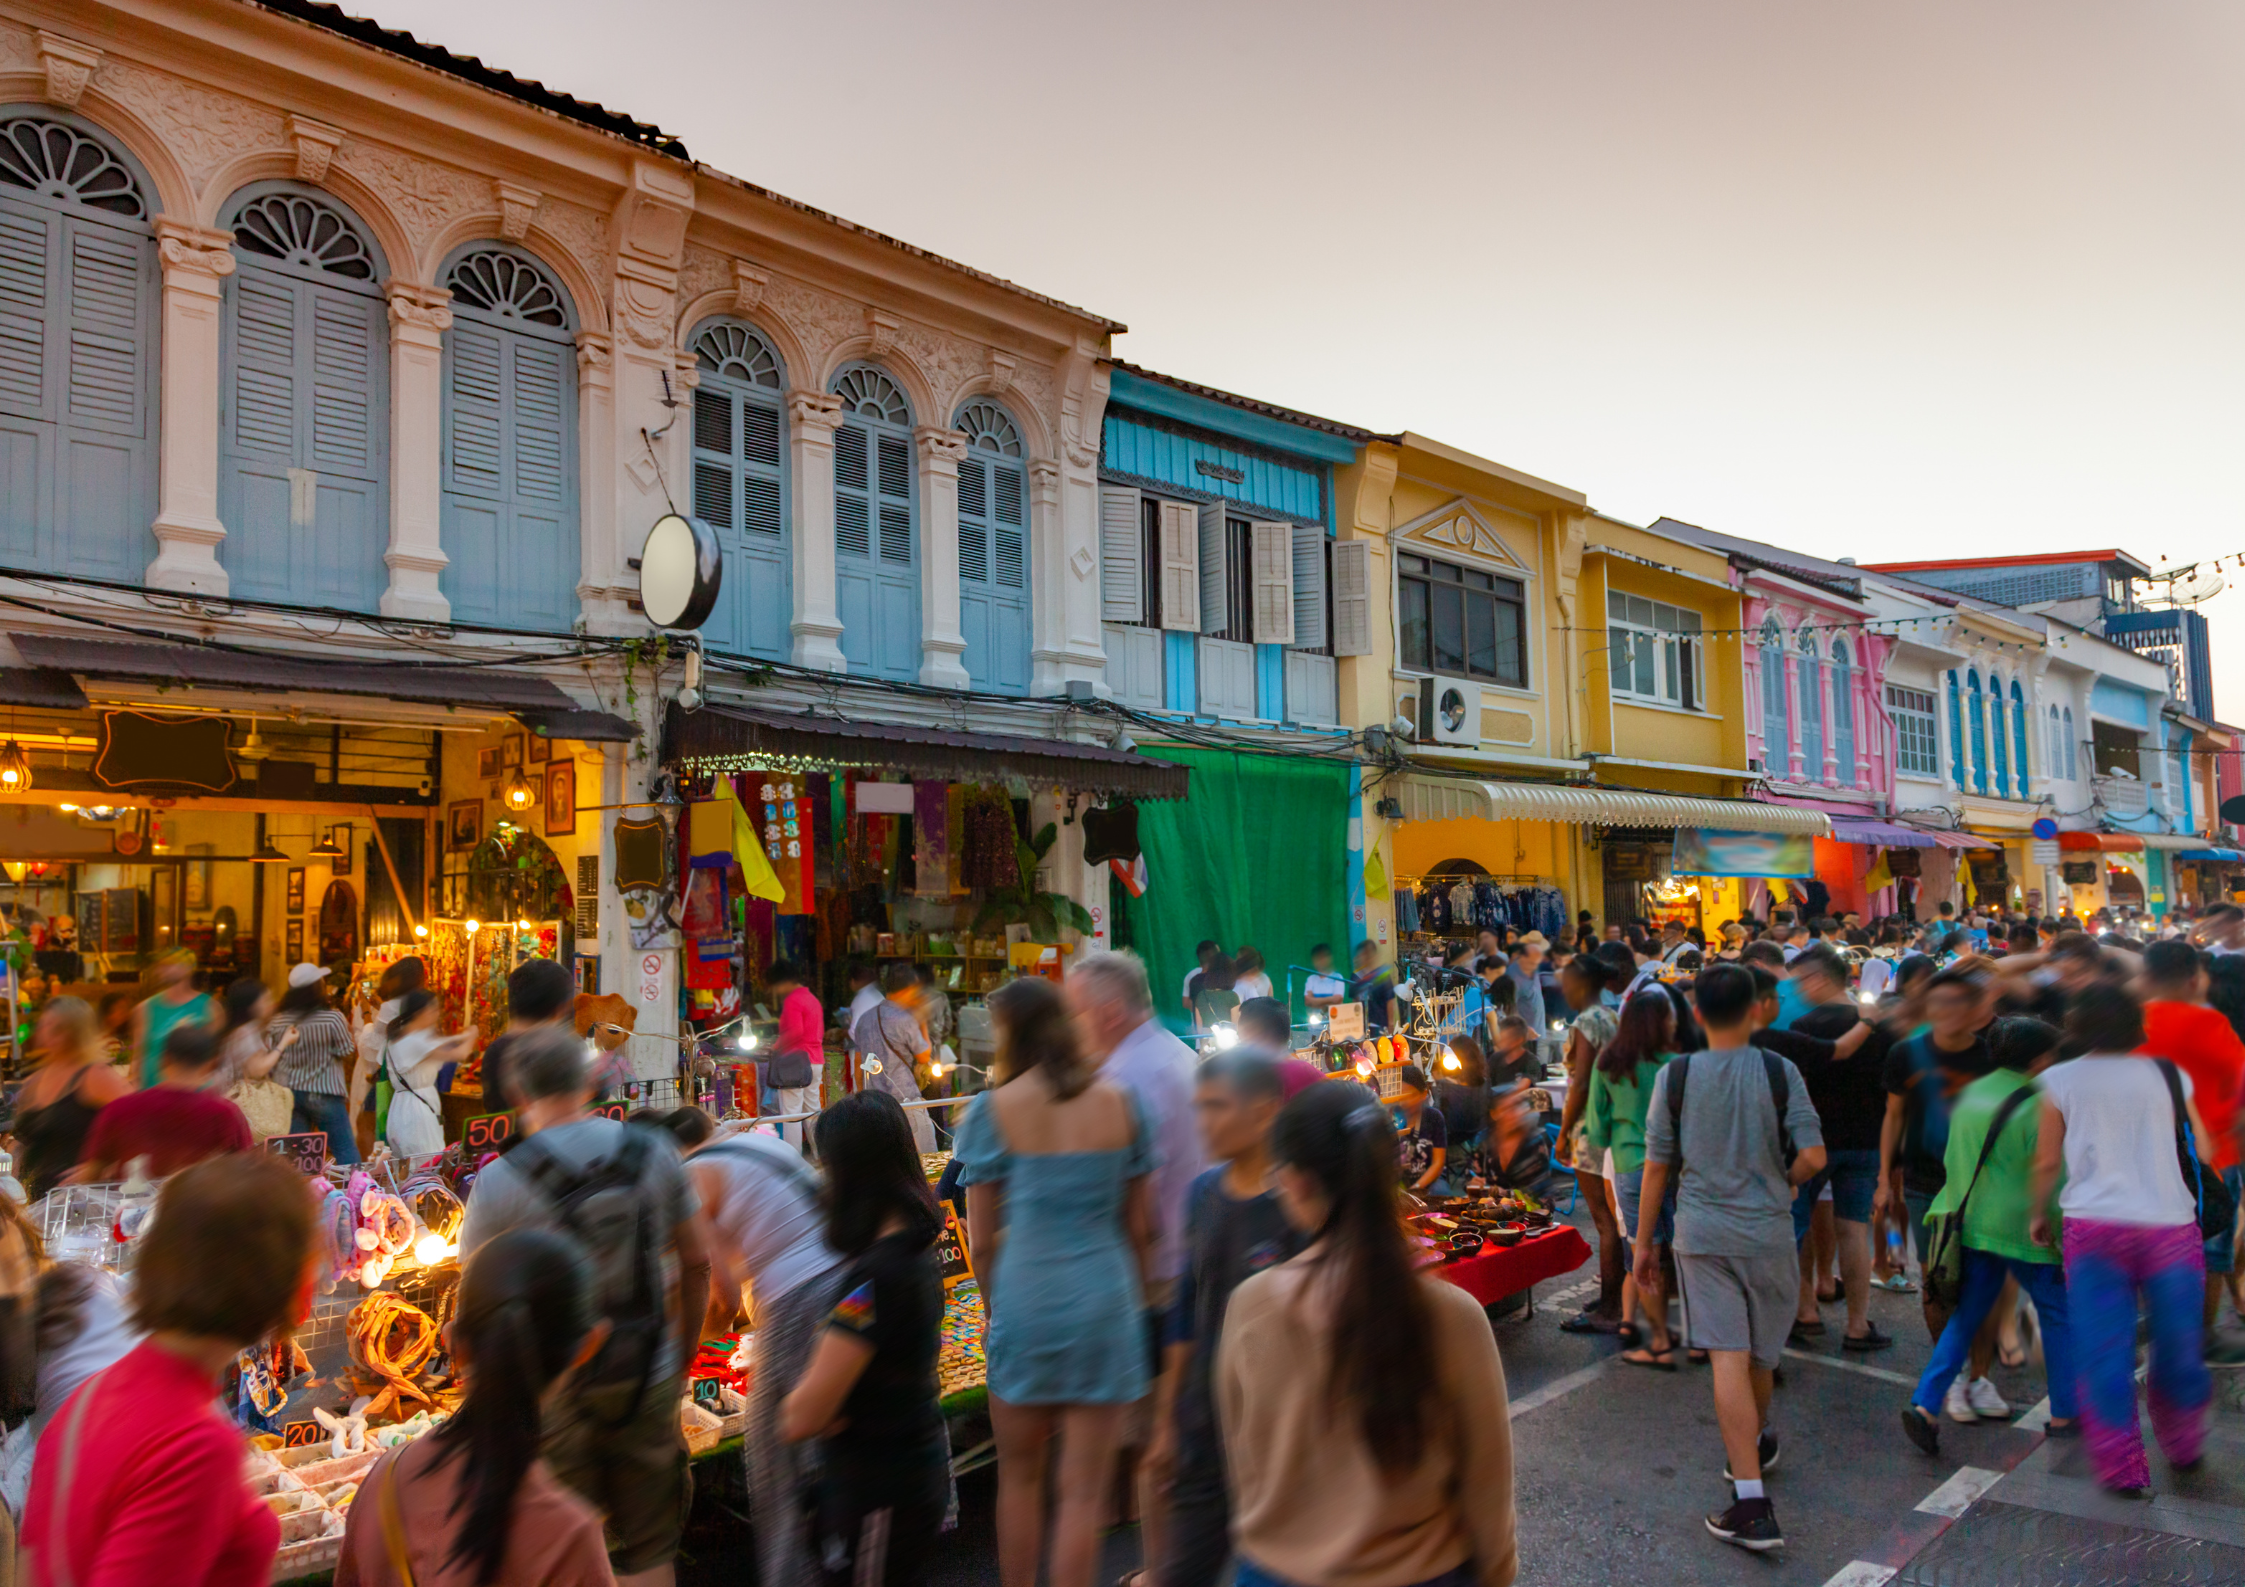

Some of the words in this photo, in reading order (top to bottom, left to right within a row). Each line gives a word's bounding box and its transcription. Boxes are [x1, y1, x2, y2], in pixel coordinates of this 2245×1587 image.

[469, 1115, 510, 1147] 50
[695, 1380, 718, 1401] 10
[287, 1423, 317, 1448] 20
